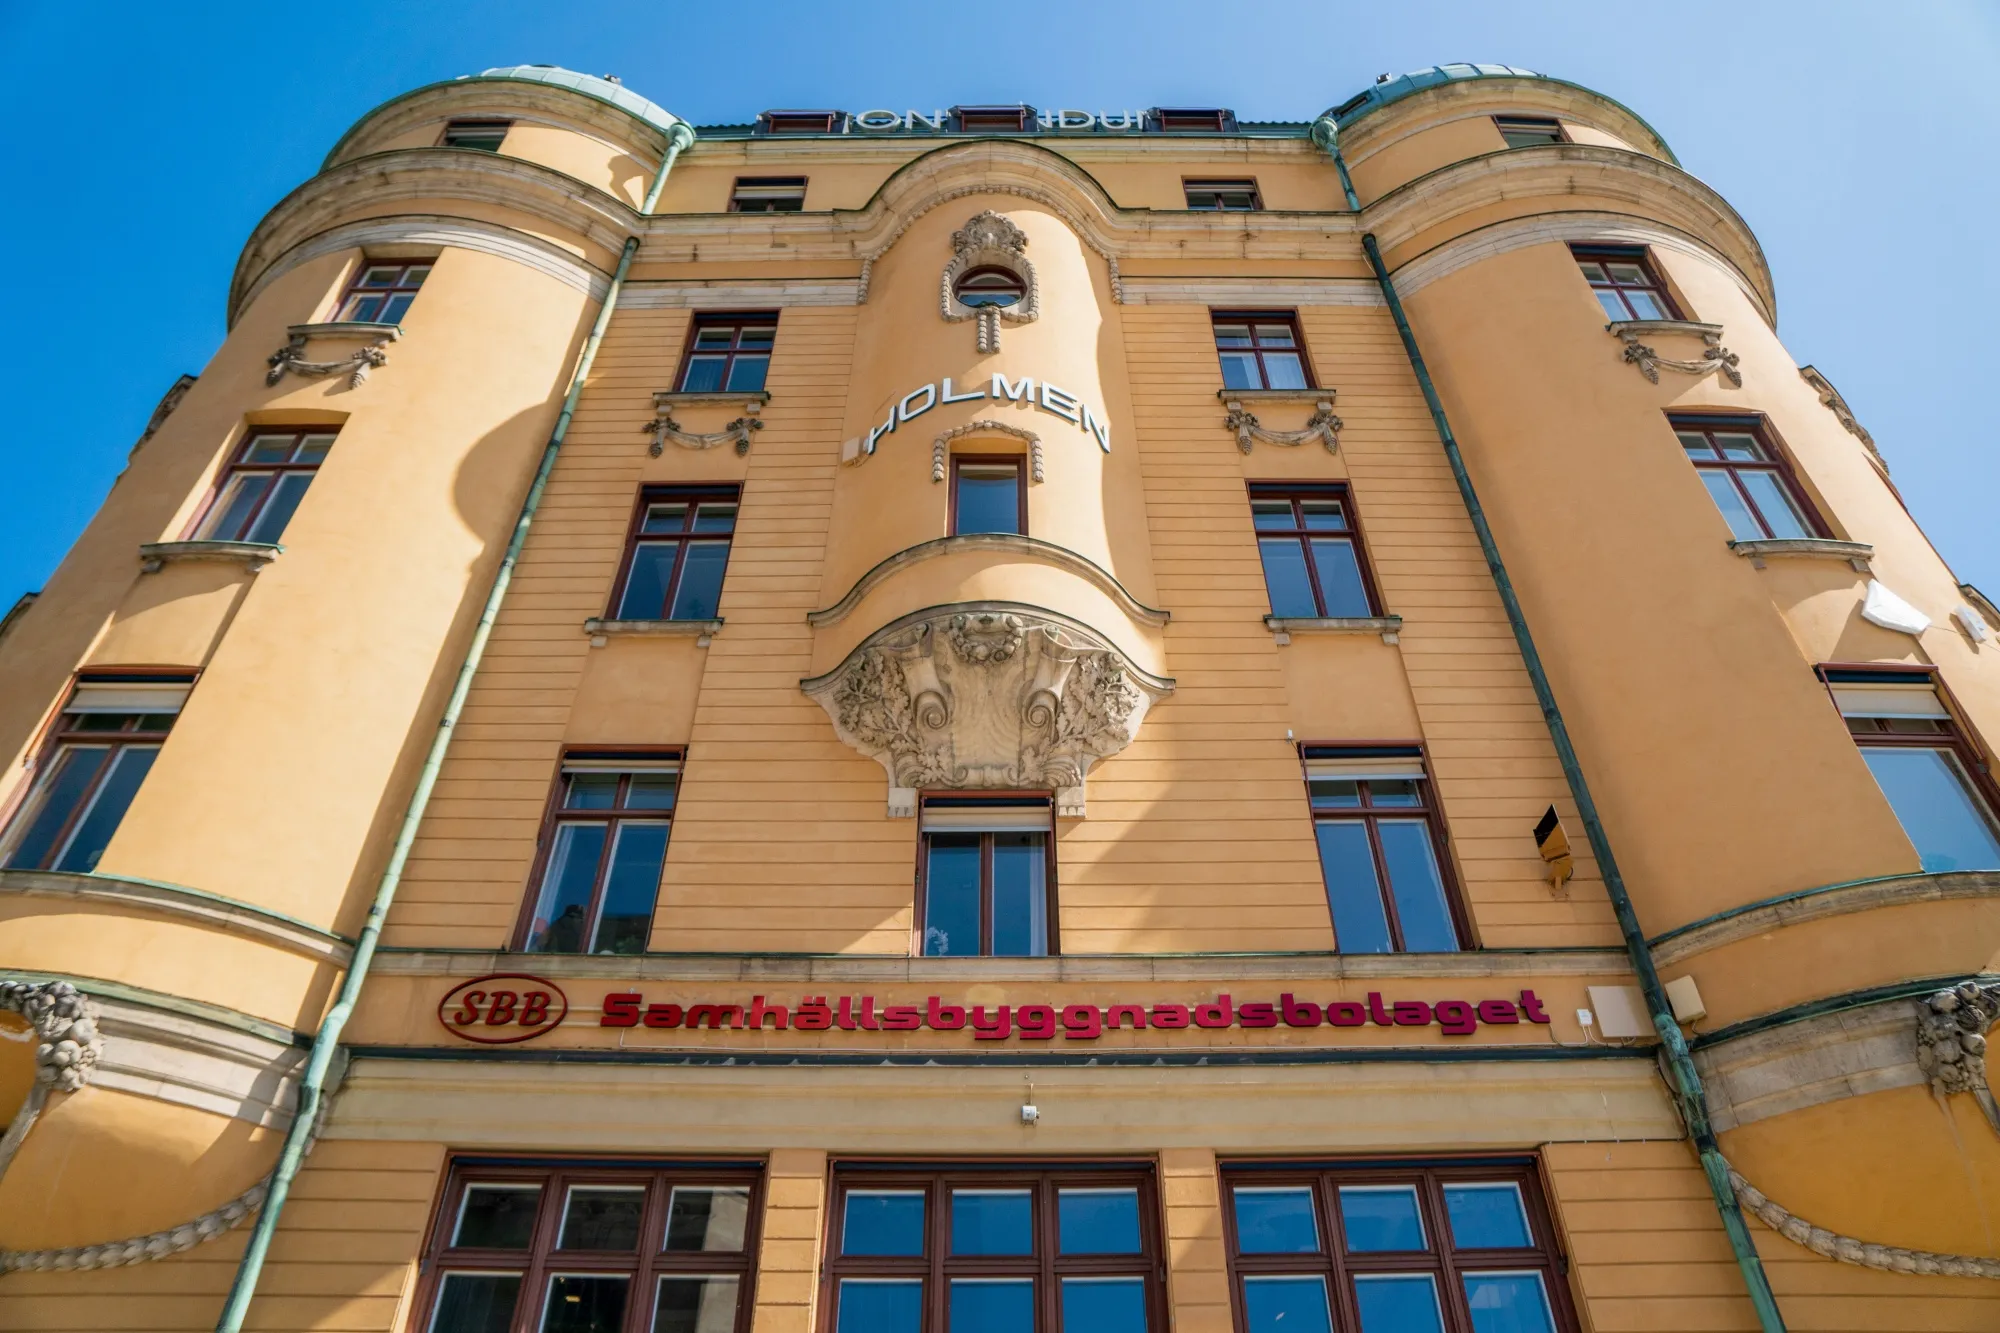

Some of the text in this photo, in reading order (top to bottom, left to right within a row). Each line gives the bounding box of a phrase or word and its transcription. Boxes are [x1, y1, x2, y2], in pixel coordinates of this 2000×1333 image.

[867, 373, 1111, 454] HOLMEN
[454, 990, 551, 1026] SBB
[600, 988, 1551, 1040] Samhällsbyggnadsbolaget
